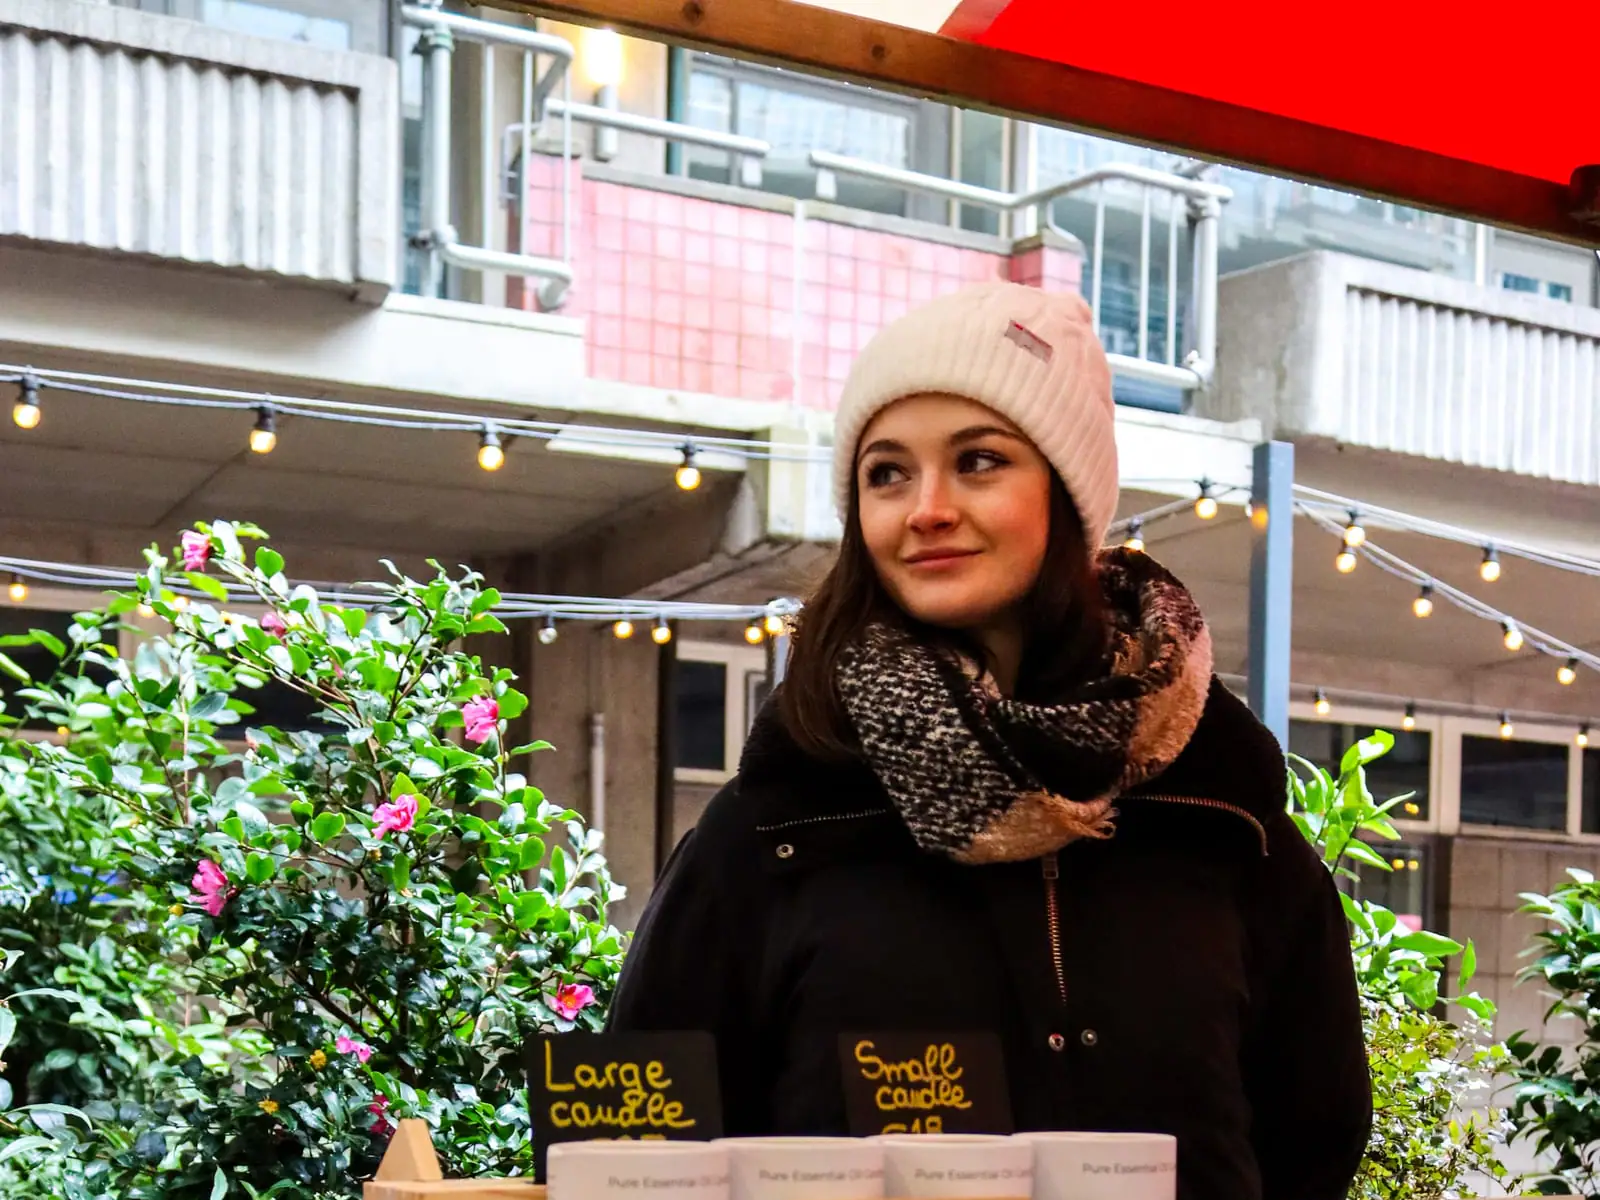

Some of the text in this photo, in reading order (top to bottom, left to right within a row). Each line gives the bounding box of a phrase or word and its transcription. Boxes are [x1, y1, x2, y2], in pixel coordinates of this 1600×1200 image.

[544, 1039, 673, 1099] Large
[854, 1040, 963, 1082] Small
[551, 1090, 696, 1128] candle
[876, 1079, 973, 1110] candle
[607, 1175, 640, 1189] Pure
